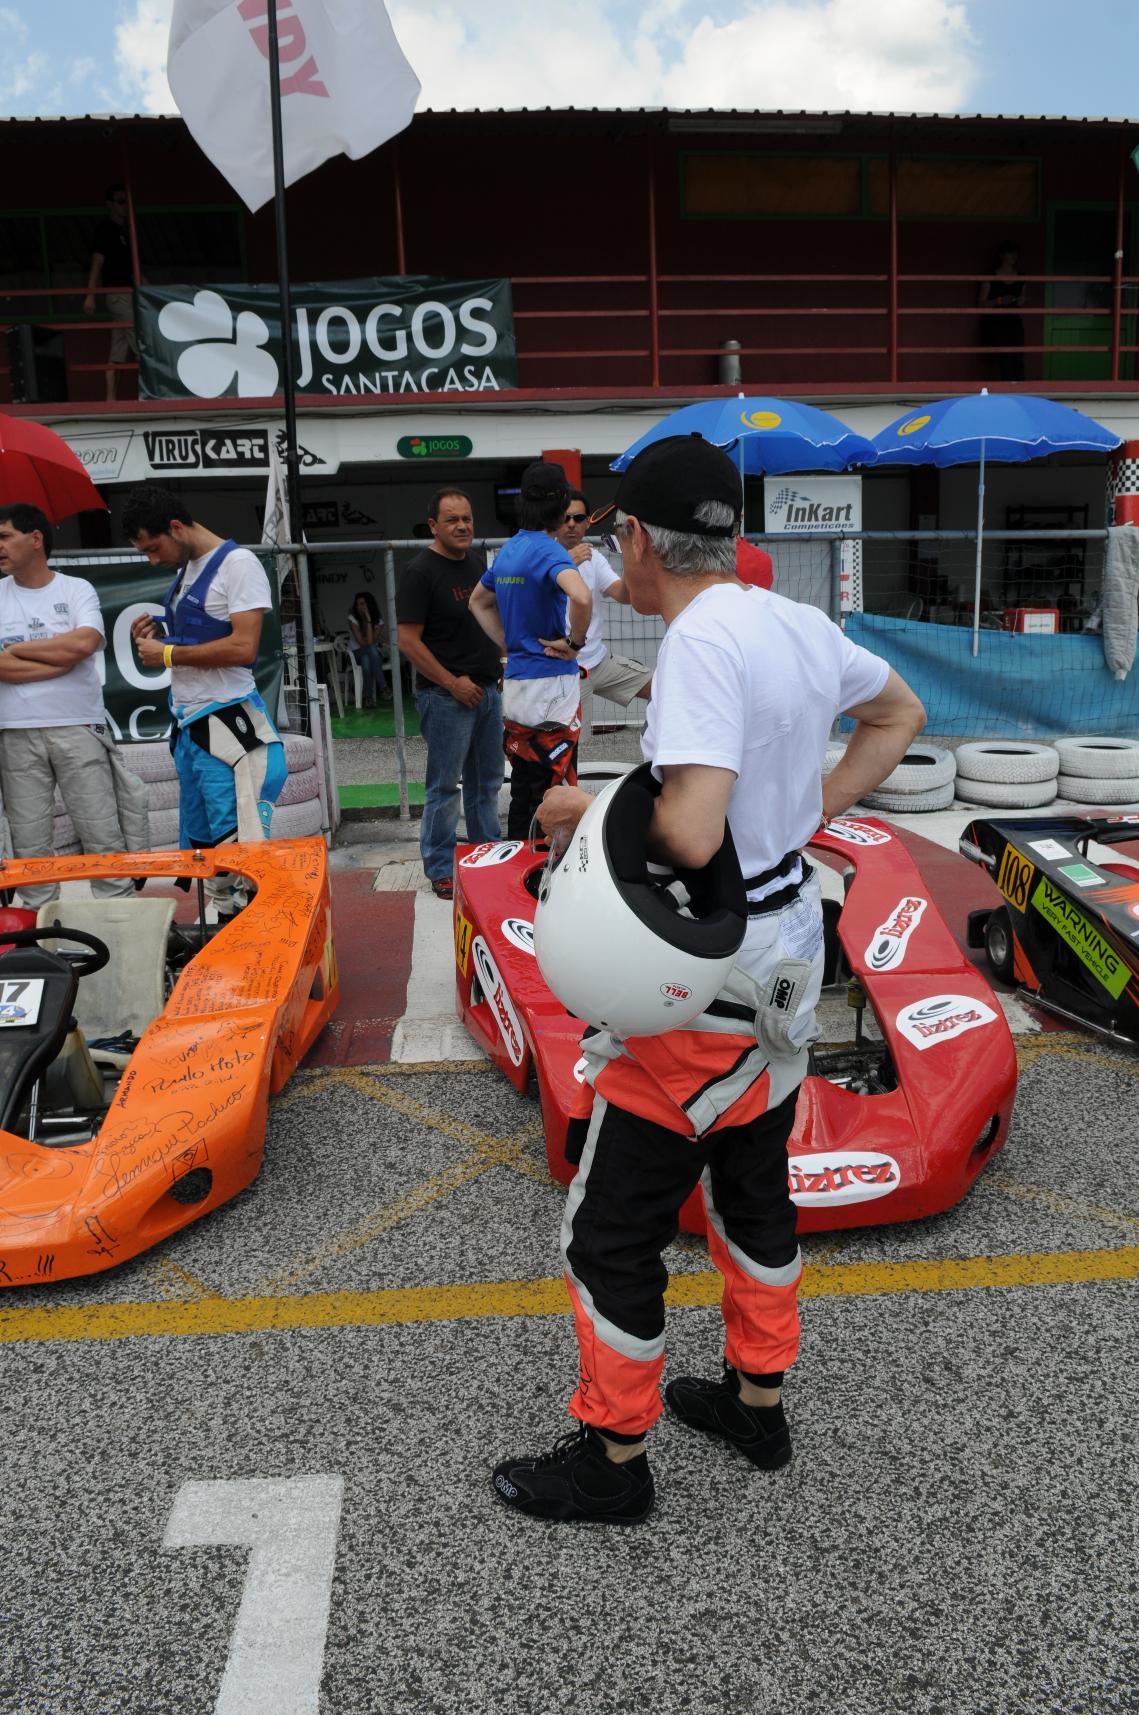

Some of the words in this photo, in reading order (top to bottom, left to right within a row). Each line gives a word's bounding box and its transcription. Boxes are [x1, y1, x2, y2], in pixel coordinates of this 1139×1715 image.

[295, 298, 498, 388] JOGOS
[143, 430, 201, 470] VIRUS
[205, 438, 265, 460] KART
[429, 440, 460, 453] JOGOS
[786, 503, 853, 523] InKart
[1001, 850, 1032, 906] 108
[1042, 902, 1062, 925] VERY
[1061, 924, 1081, 946] FAST
[1081, 945, 1110, 982] VEHICLE
[1043, 883, 1120, 974] WARNING
[665, 986, 689, 998] BELL
[775, 979, 791, 1009] OMP
[116, 1070, 137, 1109] ARMANDO
[494, 1474, 518, 1499] OMP
